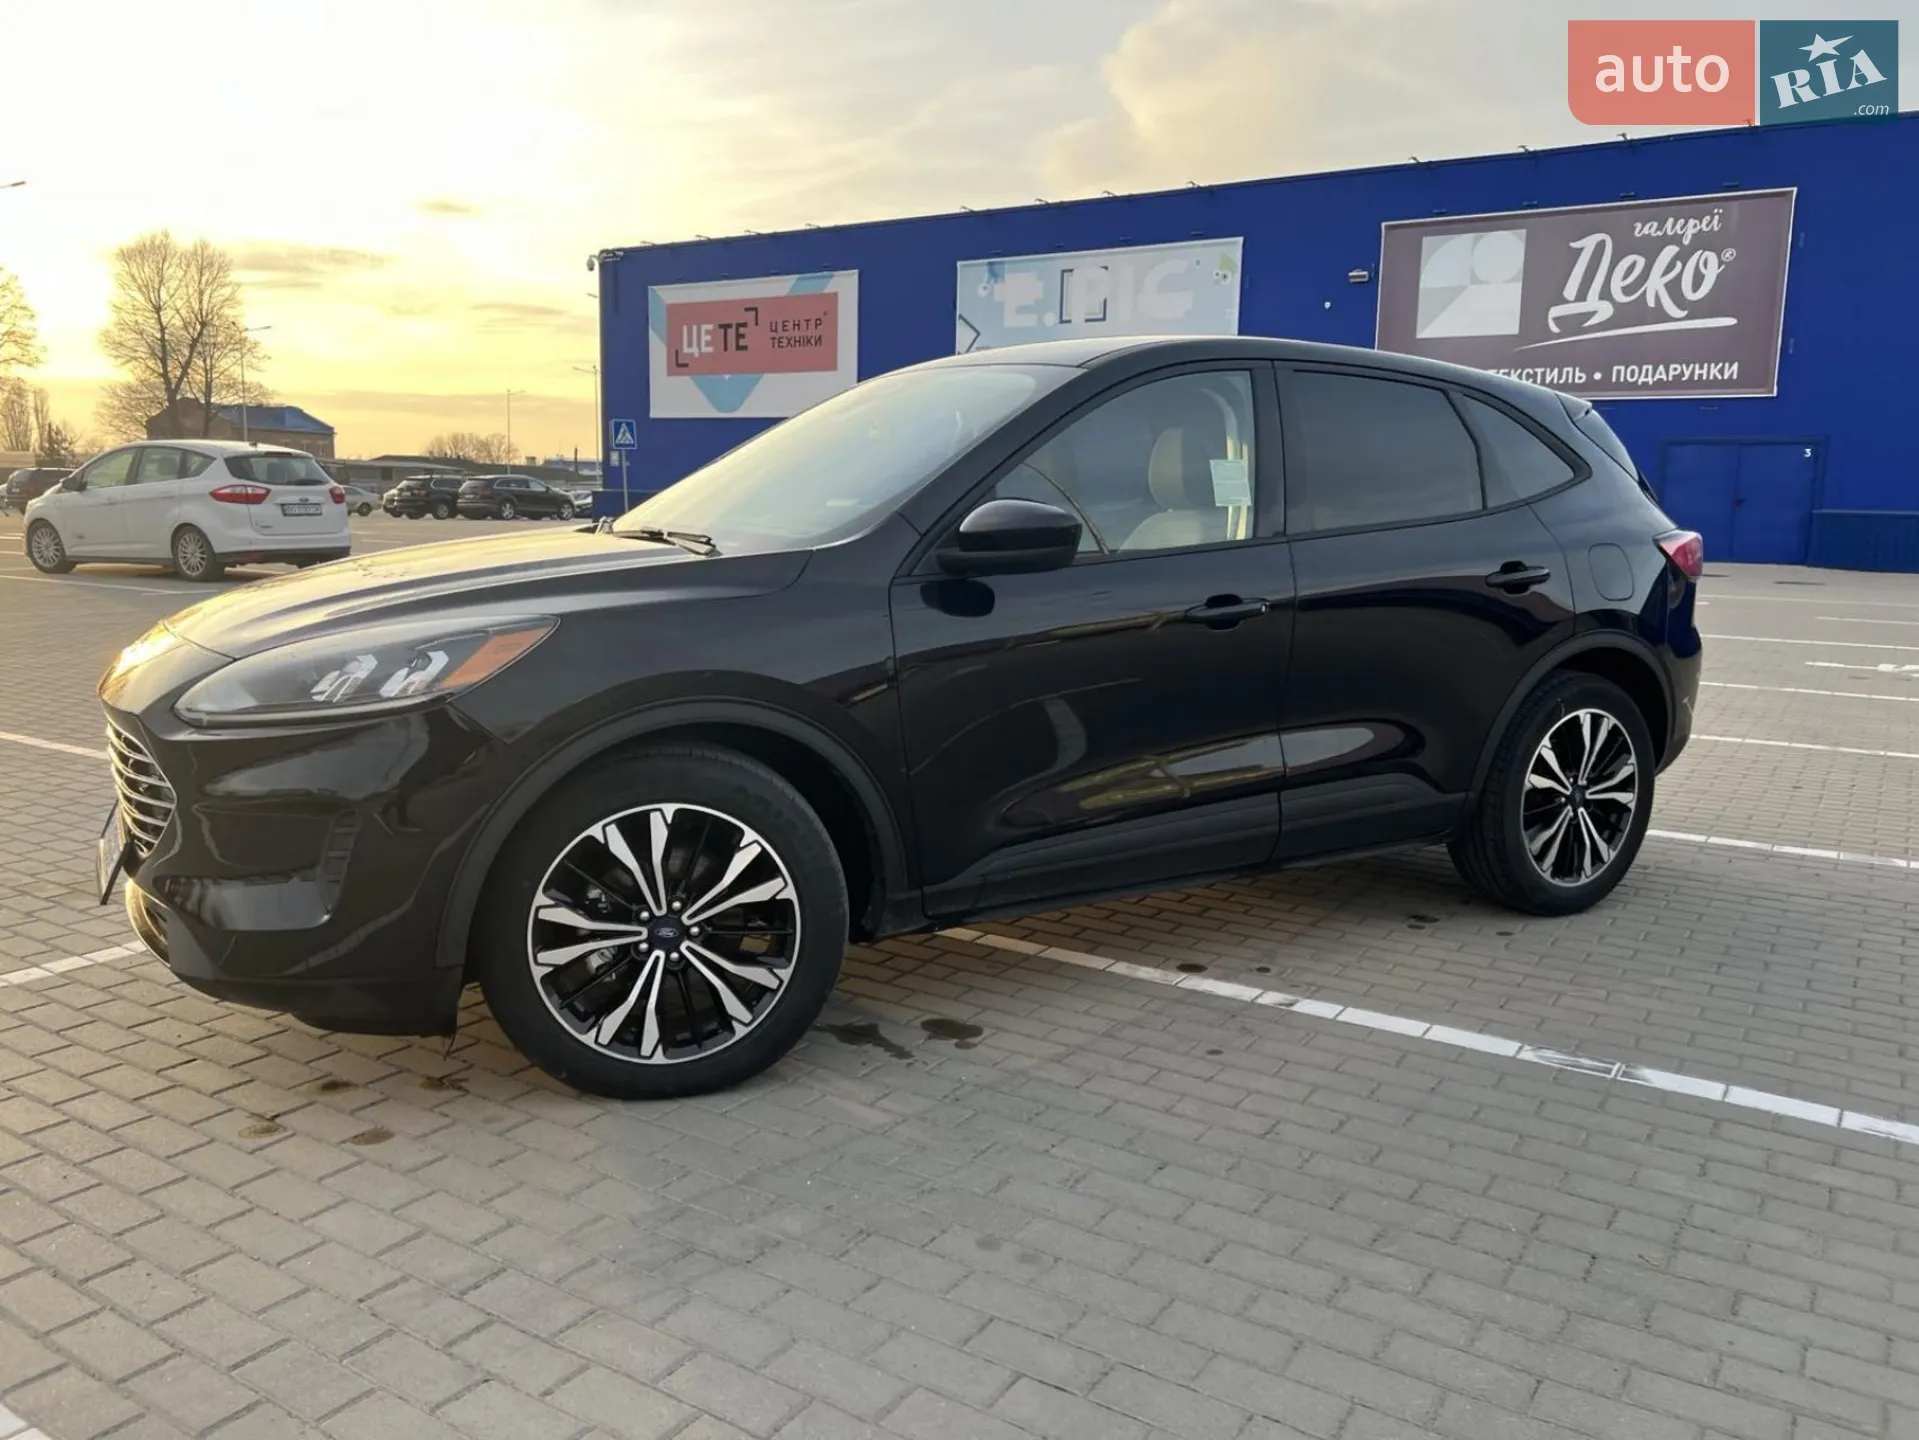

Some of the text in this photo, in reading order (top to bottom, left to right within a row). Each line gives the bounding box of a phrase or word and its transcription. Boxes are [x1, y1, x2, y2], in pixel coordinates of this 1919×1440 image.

[1633, 209, 1723, 245] галереї
[769, 318, 823, 334] ЦЕНТР
[770, 335, 822, 349] ТЕХНІКИ
[1611, 362, 1738, 385] ПОДАРУНКИ
[1804, 448, 1812, 458] 3
